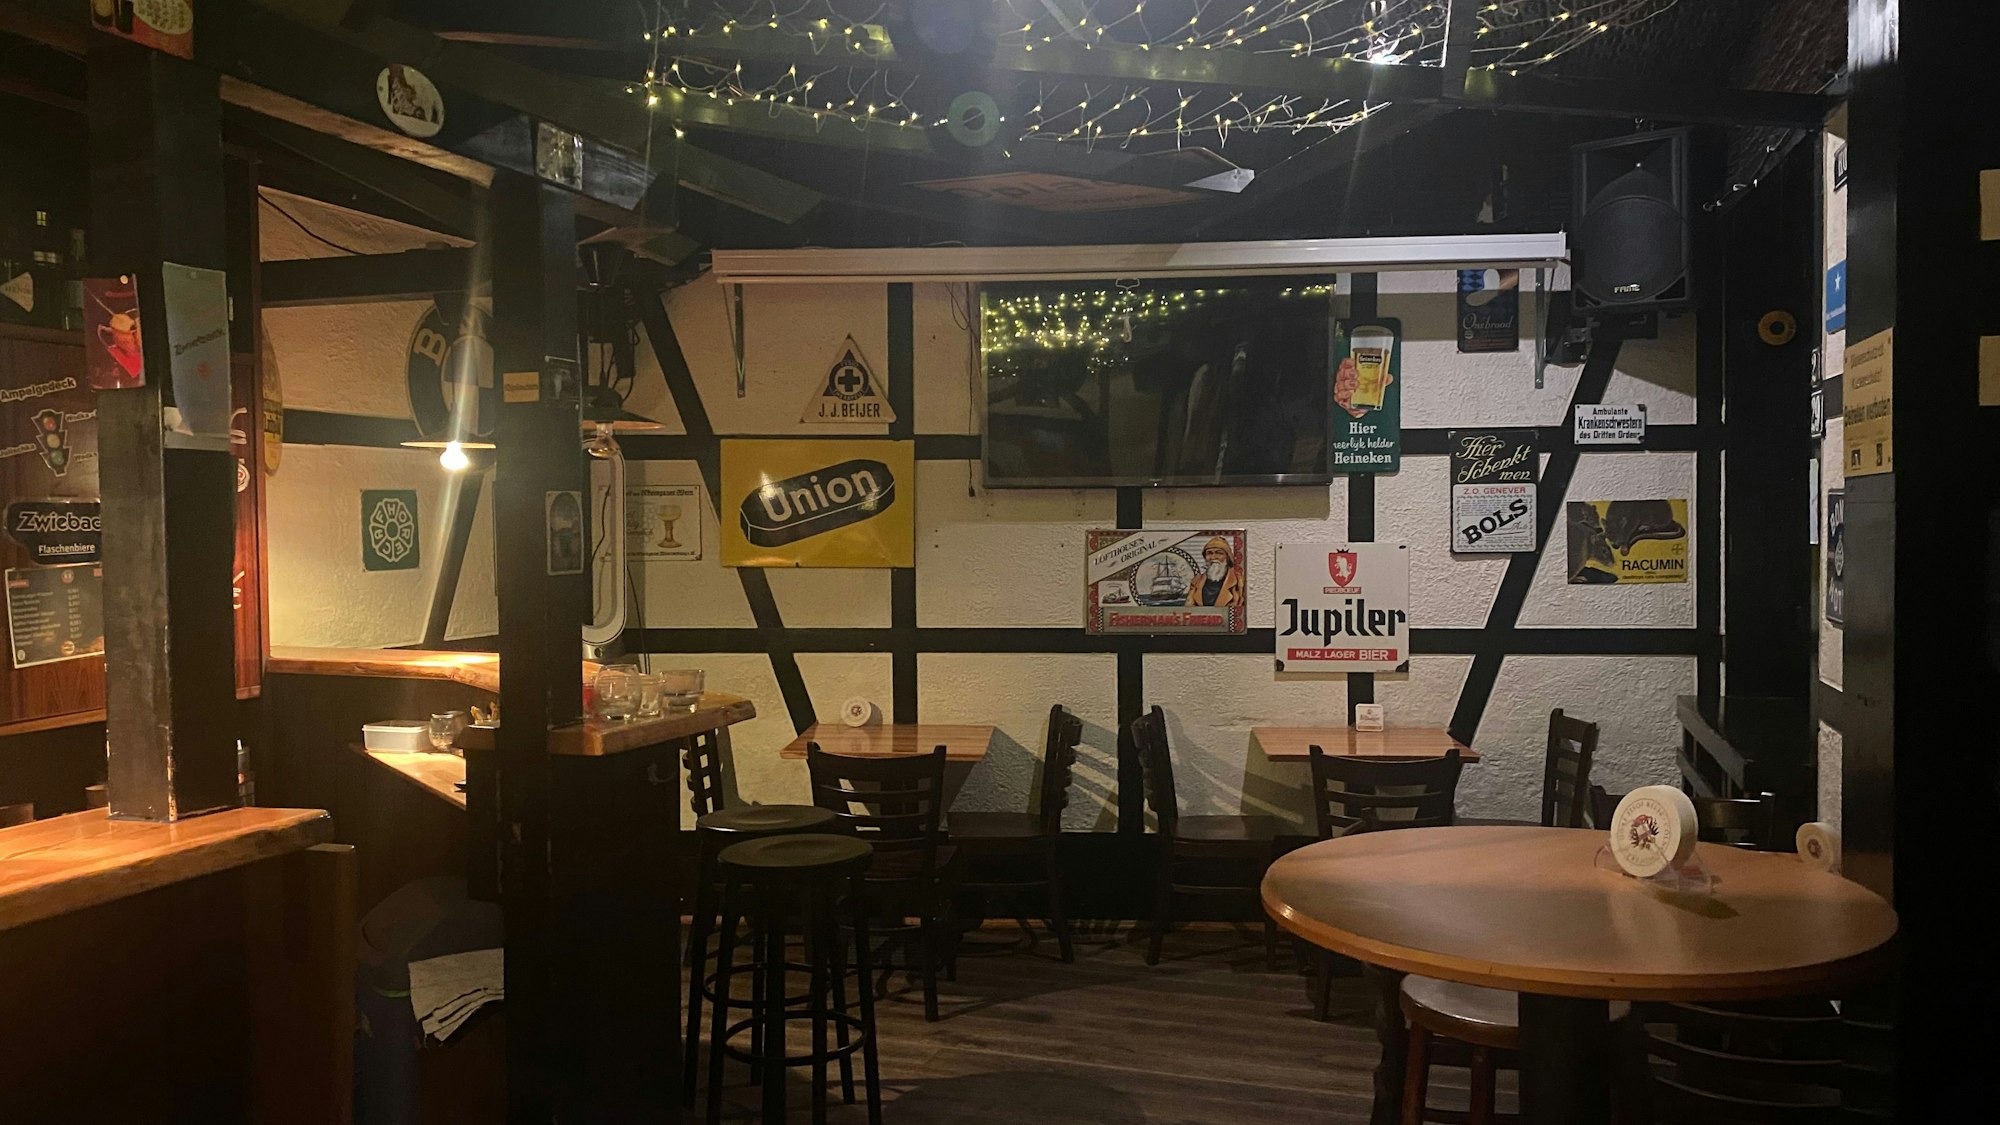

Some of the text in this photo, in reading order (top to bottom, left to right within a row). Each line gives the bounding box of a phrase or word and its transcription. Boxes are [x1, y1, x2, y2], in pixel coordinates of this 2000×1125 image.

[1, 378, 76, 400] Ampelgedeck
[1592, 407, 1629, 415] Ambulante
[1349, 421, 1377, 435] Hier
[1578, 416, 1643, 430] Krankenschwestern
[1579, 431, 1591, 439] des
[1593, 430, 1616, 439] Dritten
[1367, 437, 1395, 449] helder
[1455, 435, 1506, 461] Hier
[1334, 451, 1393, 464] Heineken
[1457, 444, 1532, 483] Schenkt
[1498, 470, 1532, 481] men
[758, 470, 880, 523] Union
[1484, 486, 1527, 495] GENEVER
[1461, 498, 1528, 545] BOLS
[38, 543, 96, 555] Flaschenbiere
[1120, 541, 1157, 563] ORIGINAL
[1621, 559, 1684, 571] RACUMIN
[1182, 611, 1224, 627] FRIEND
[1279, 598, 1406, 647] Jupiler
[1295, 649, 1389, 660] MALZ LAGER BIER
